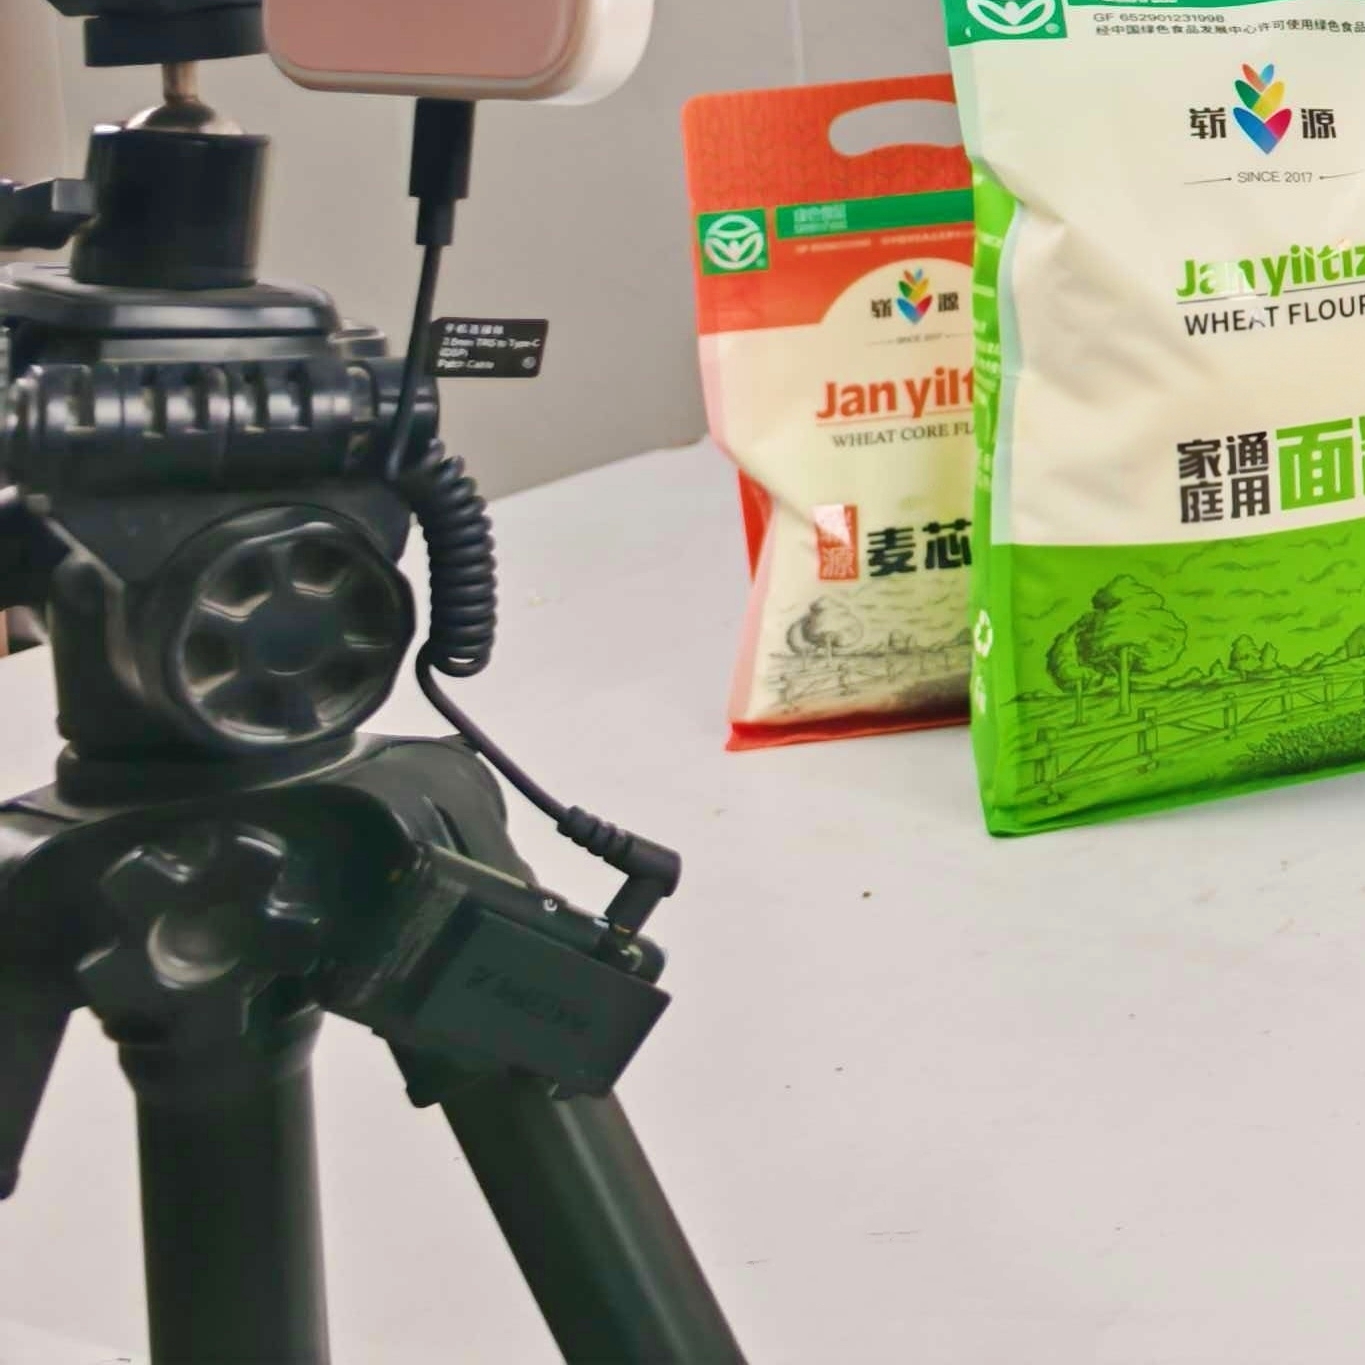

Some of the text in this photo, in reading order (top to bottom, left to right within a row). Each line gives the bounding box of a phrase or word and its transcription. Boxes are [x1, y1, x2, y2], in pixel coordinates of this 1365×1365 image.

[1093, 13, 1114, 22] GF
[1301, 108, 1337, 139] 源
[1237, 171, 1313, 183] SINCE 2017
[1184, 305, 1280, 336] WHEAT
[832, 429, 898, 448] WHEAT
[900, 424, 949, 442] CORE
